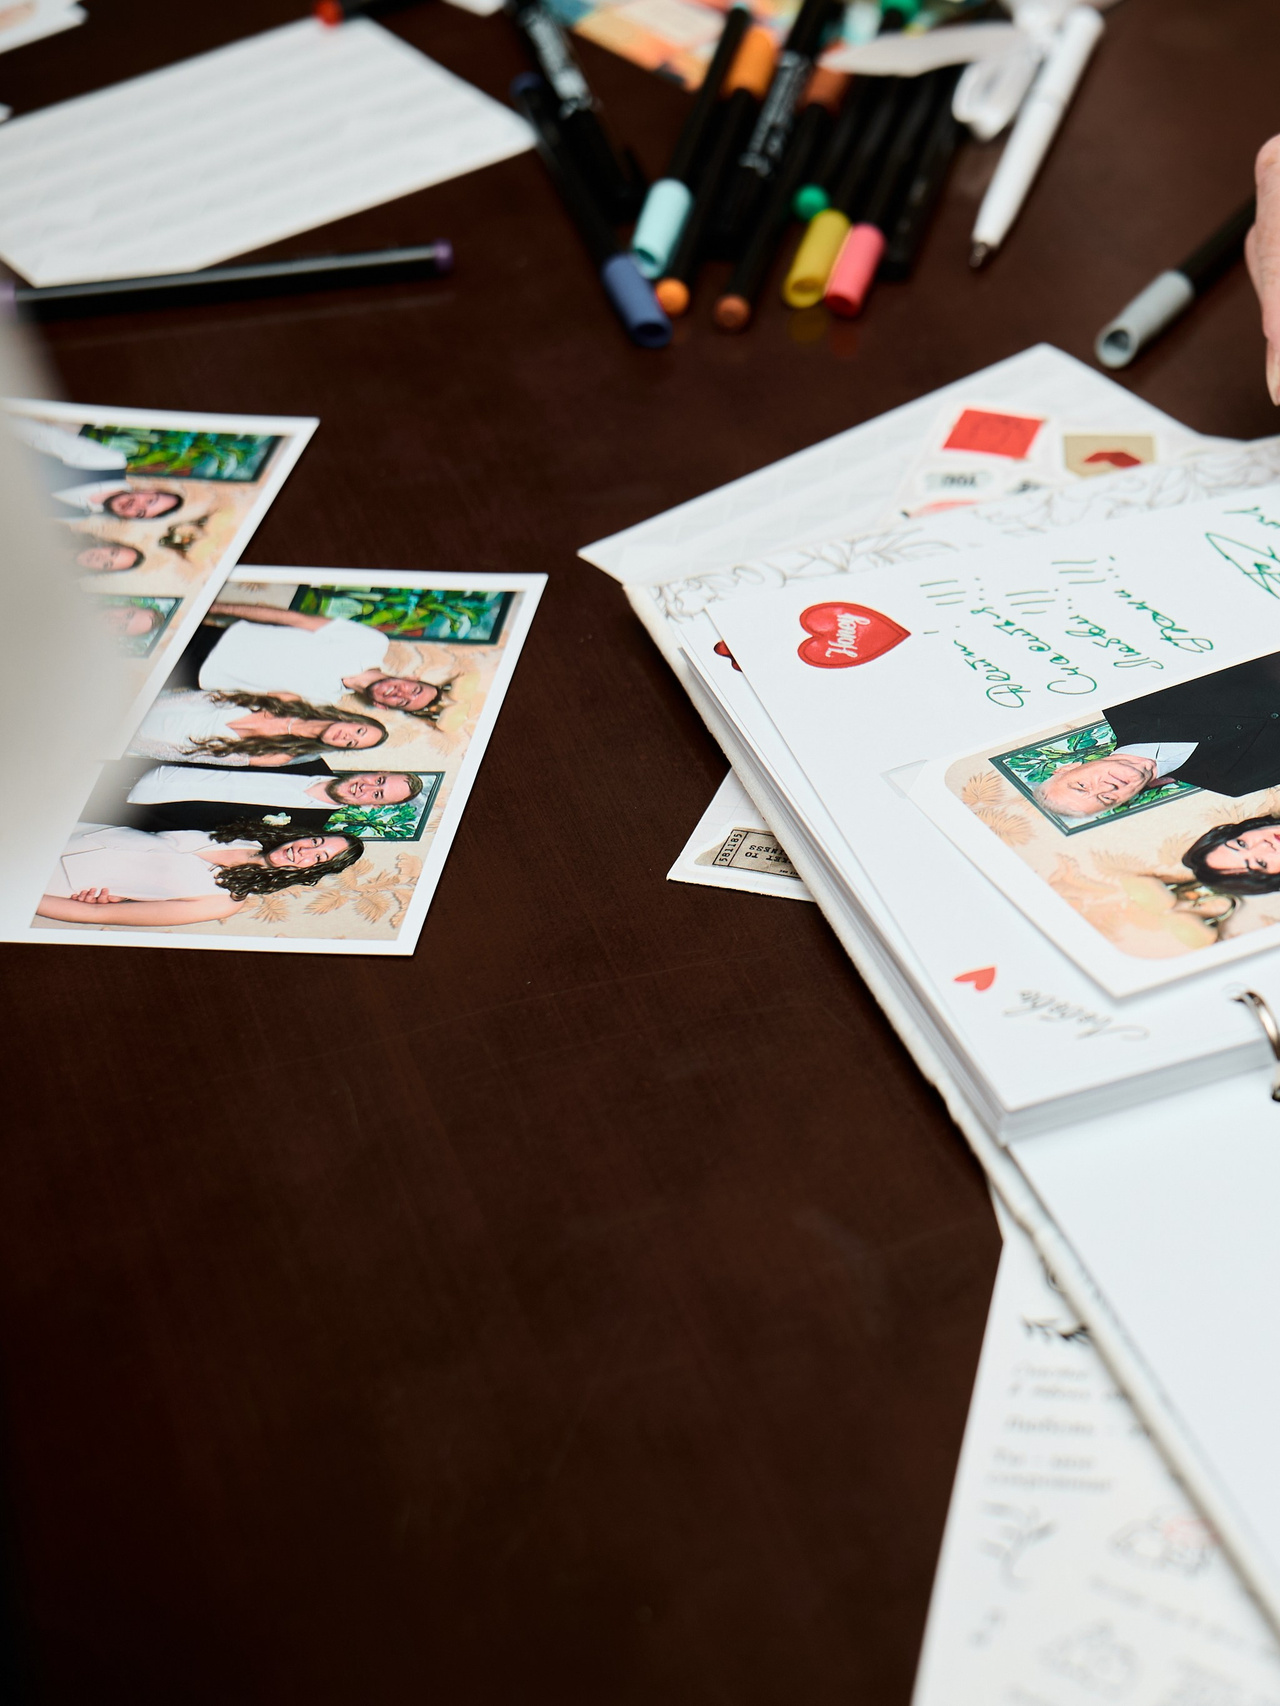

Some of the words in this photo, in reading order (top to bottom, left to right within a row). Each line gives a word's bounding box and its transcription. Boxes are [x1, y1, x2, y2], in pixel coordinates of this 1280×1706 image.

[825, 613, 871, 658] Honey
[718, 833, 743, 862] 581185
[748, 844, 784, 854] INESS
[744, 851, 759, 859] TO
[765, 855, 792, 864] KET
